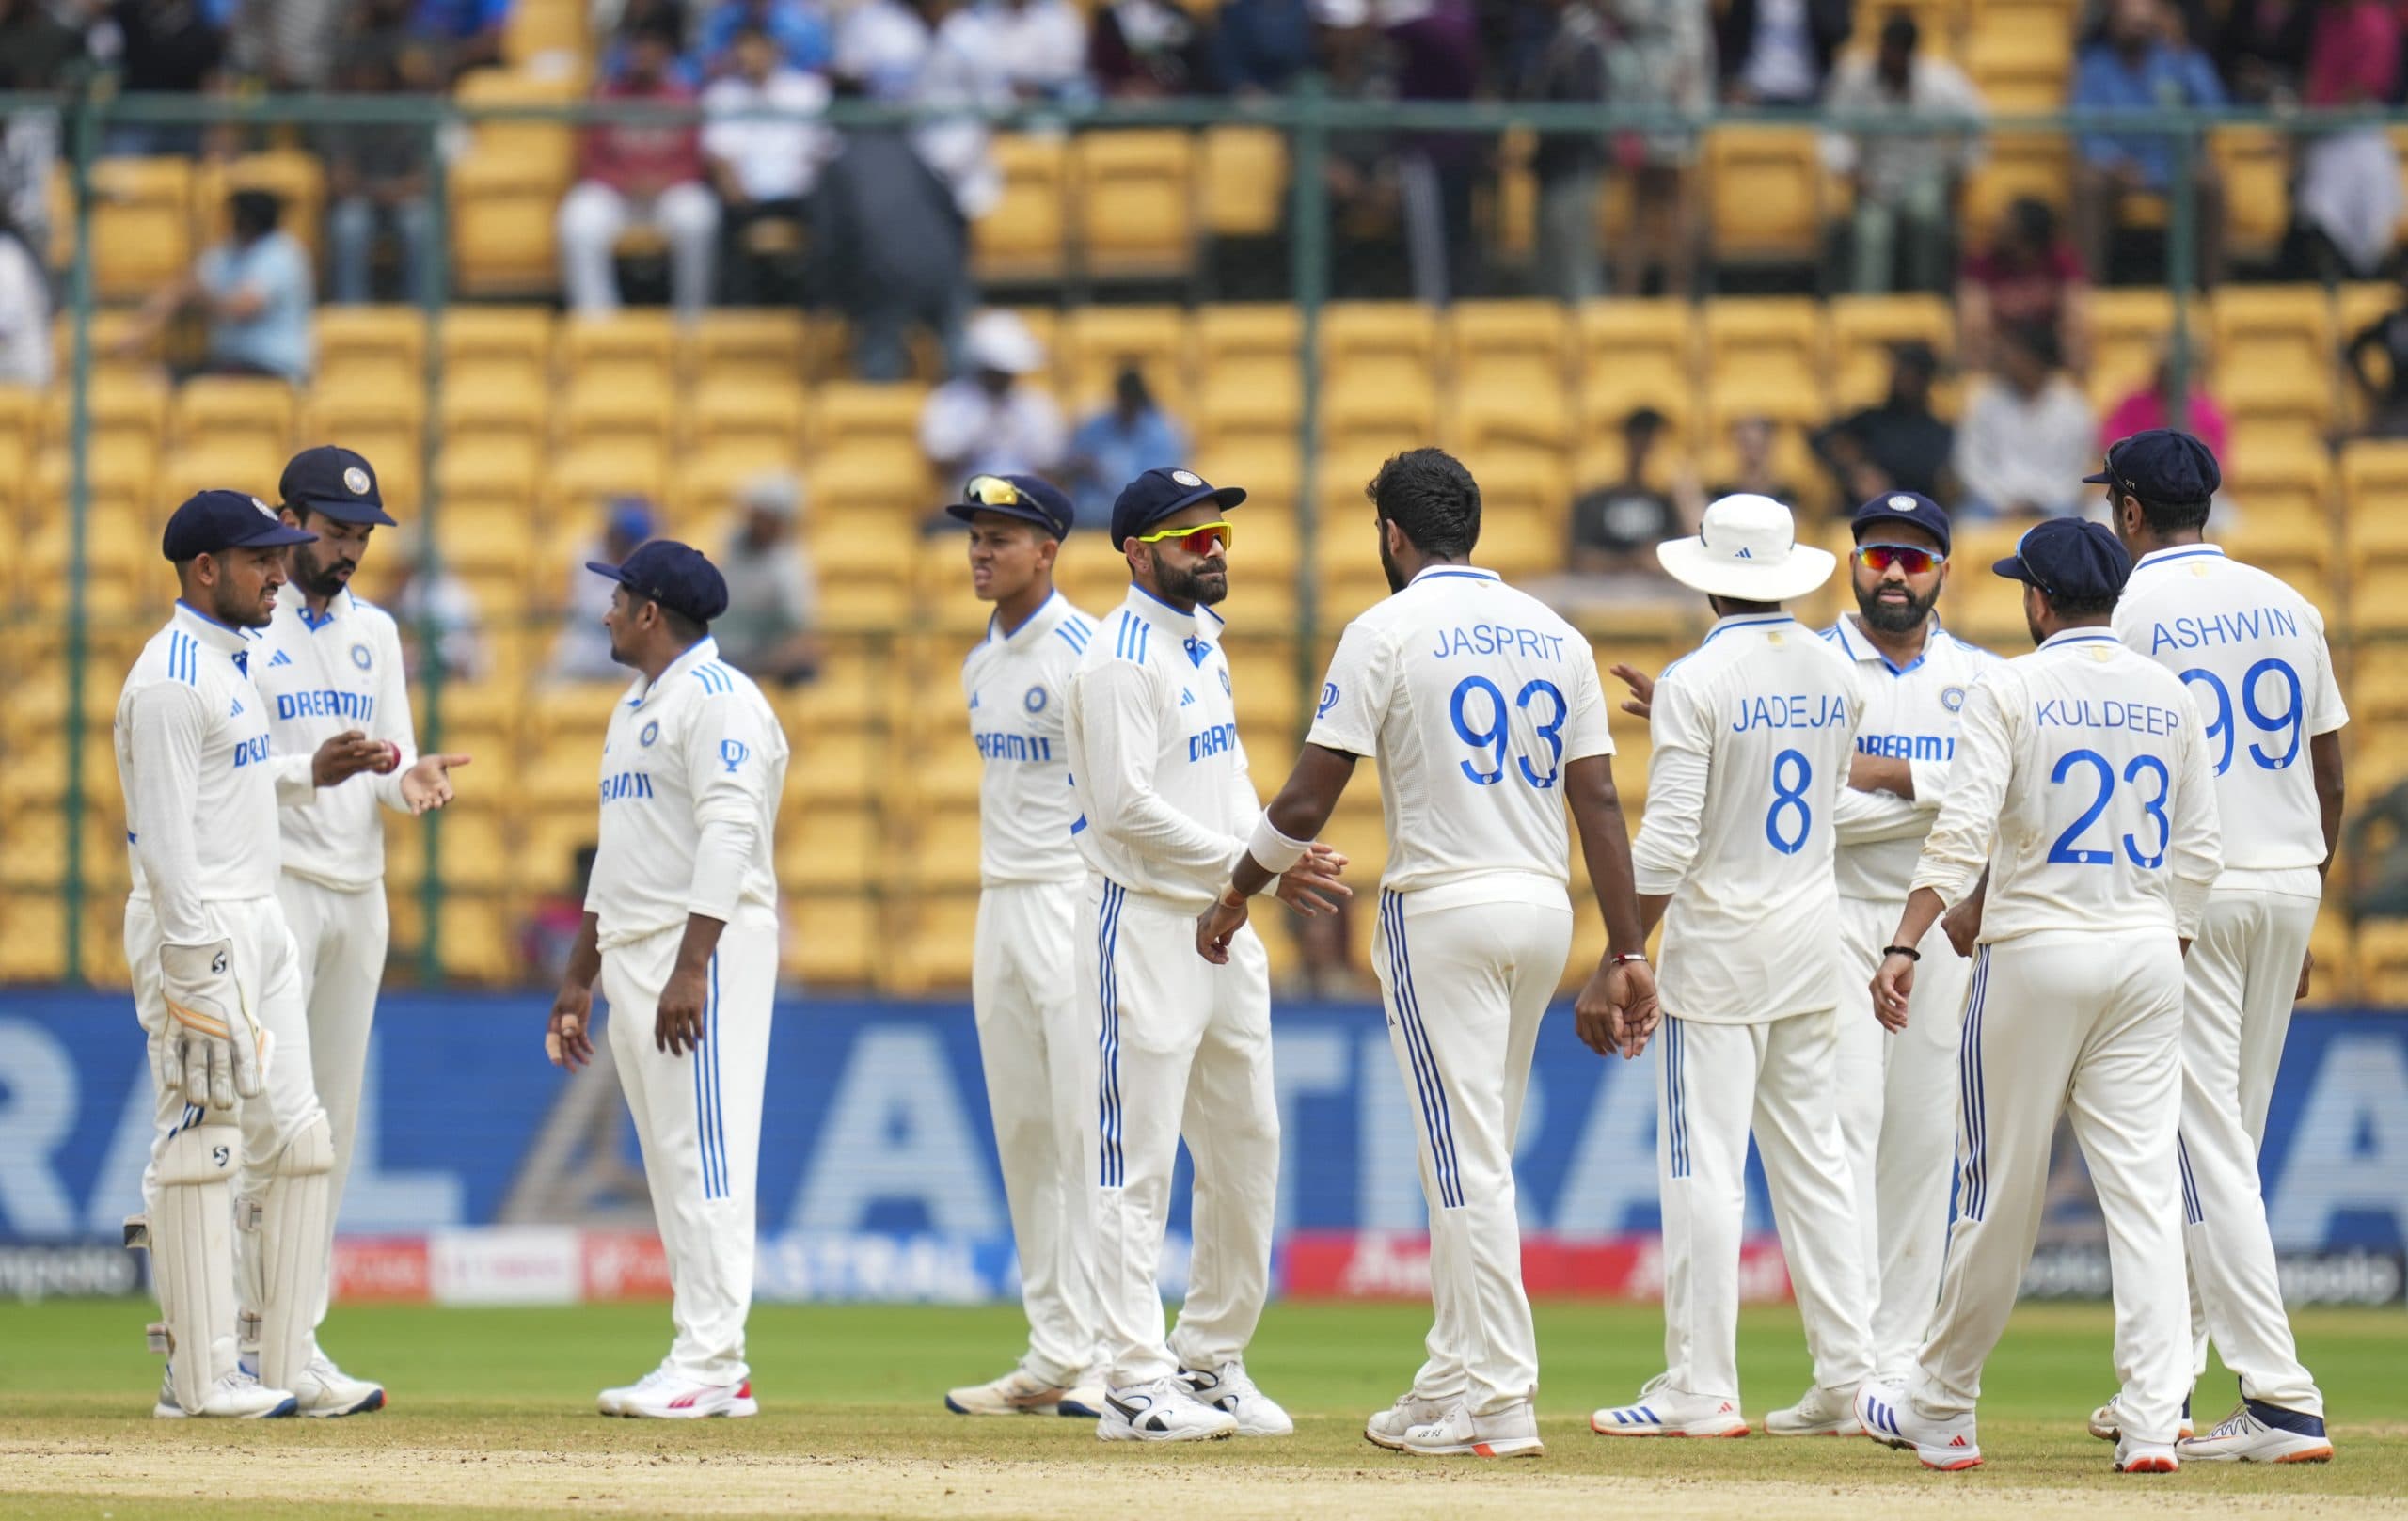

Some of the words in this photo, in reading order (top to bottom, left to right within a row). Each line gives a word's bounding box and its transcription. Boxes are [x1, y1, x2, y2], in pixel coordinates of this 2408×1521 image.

[1434, 624, 1563, 663] JASPRIT
[2152, 608, 2297, 656] ASHWIN
[1450, 675, 1567, 789] 93
[1732, 694, 1846, 733] JADEJA
[2036, 699, 2179, 737] KULDEEP
[2178, 658, 2303, 779] 99
[1766, 748, 1812, 855] 8
[2047, 749, 2170, 870] 23
